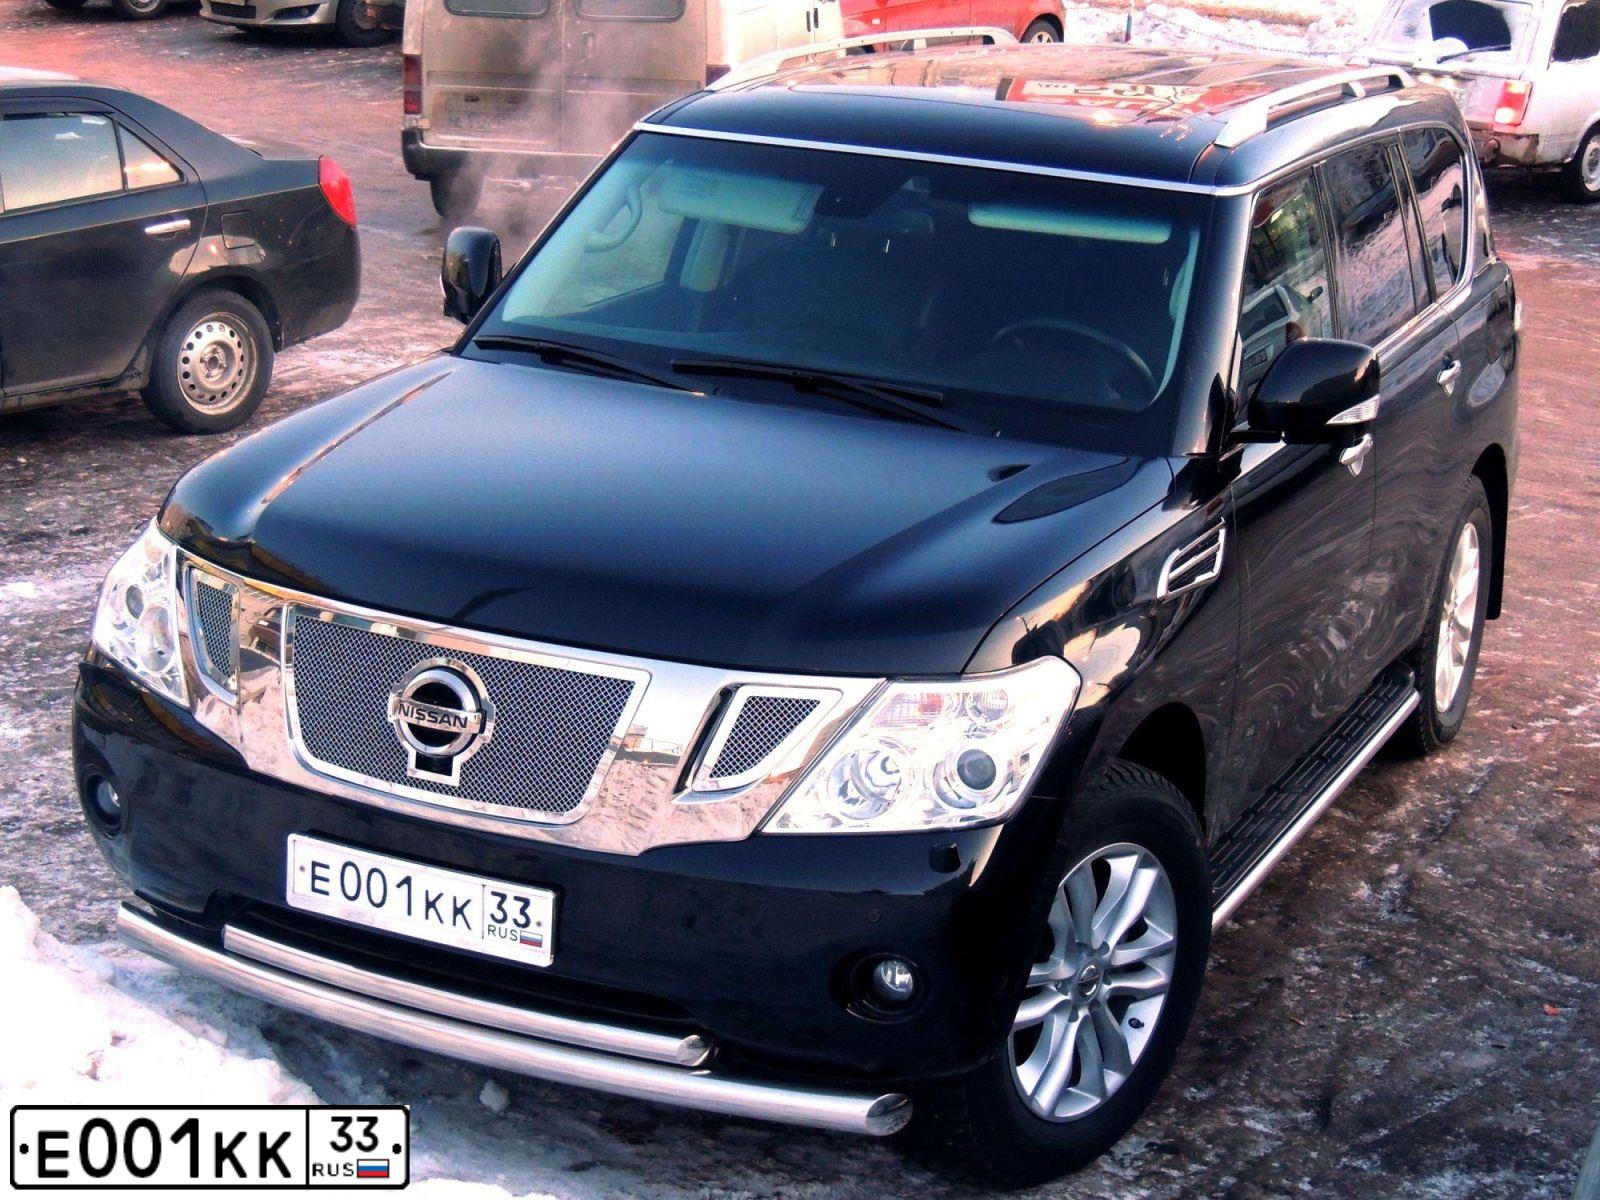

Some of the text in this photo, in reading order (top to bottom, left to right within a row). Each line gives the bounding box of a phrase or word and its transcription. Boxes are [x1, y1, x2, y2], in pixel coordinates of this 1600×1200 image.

[398, 703, 468, 729] NISSAN
[490, 890, 531, 929] 33
[487, 924, 518, 942] RUS
